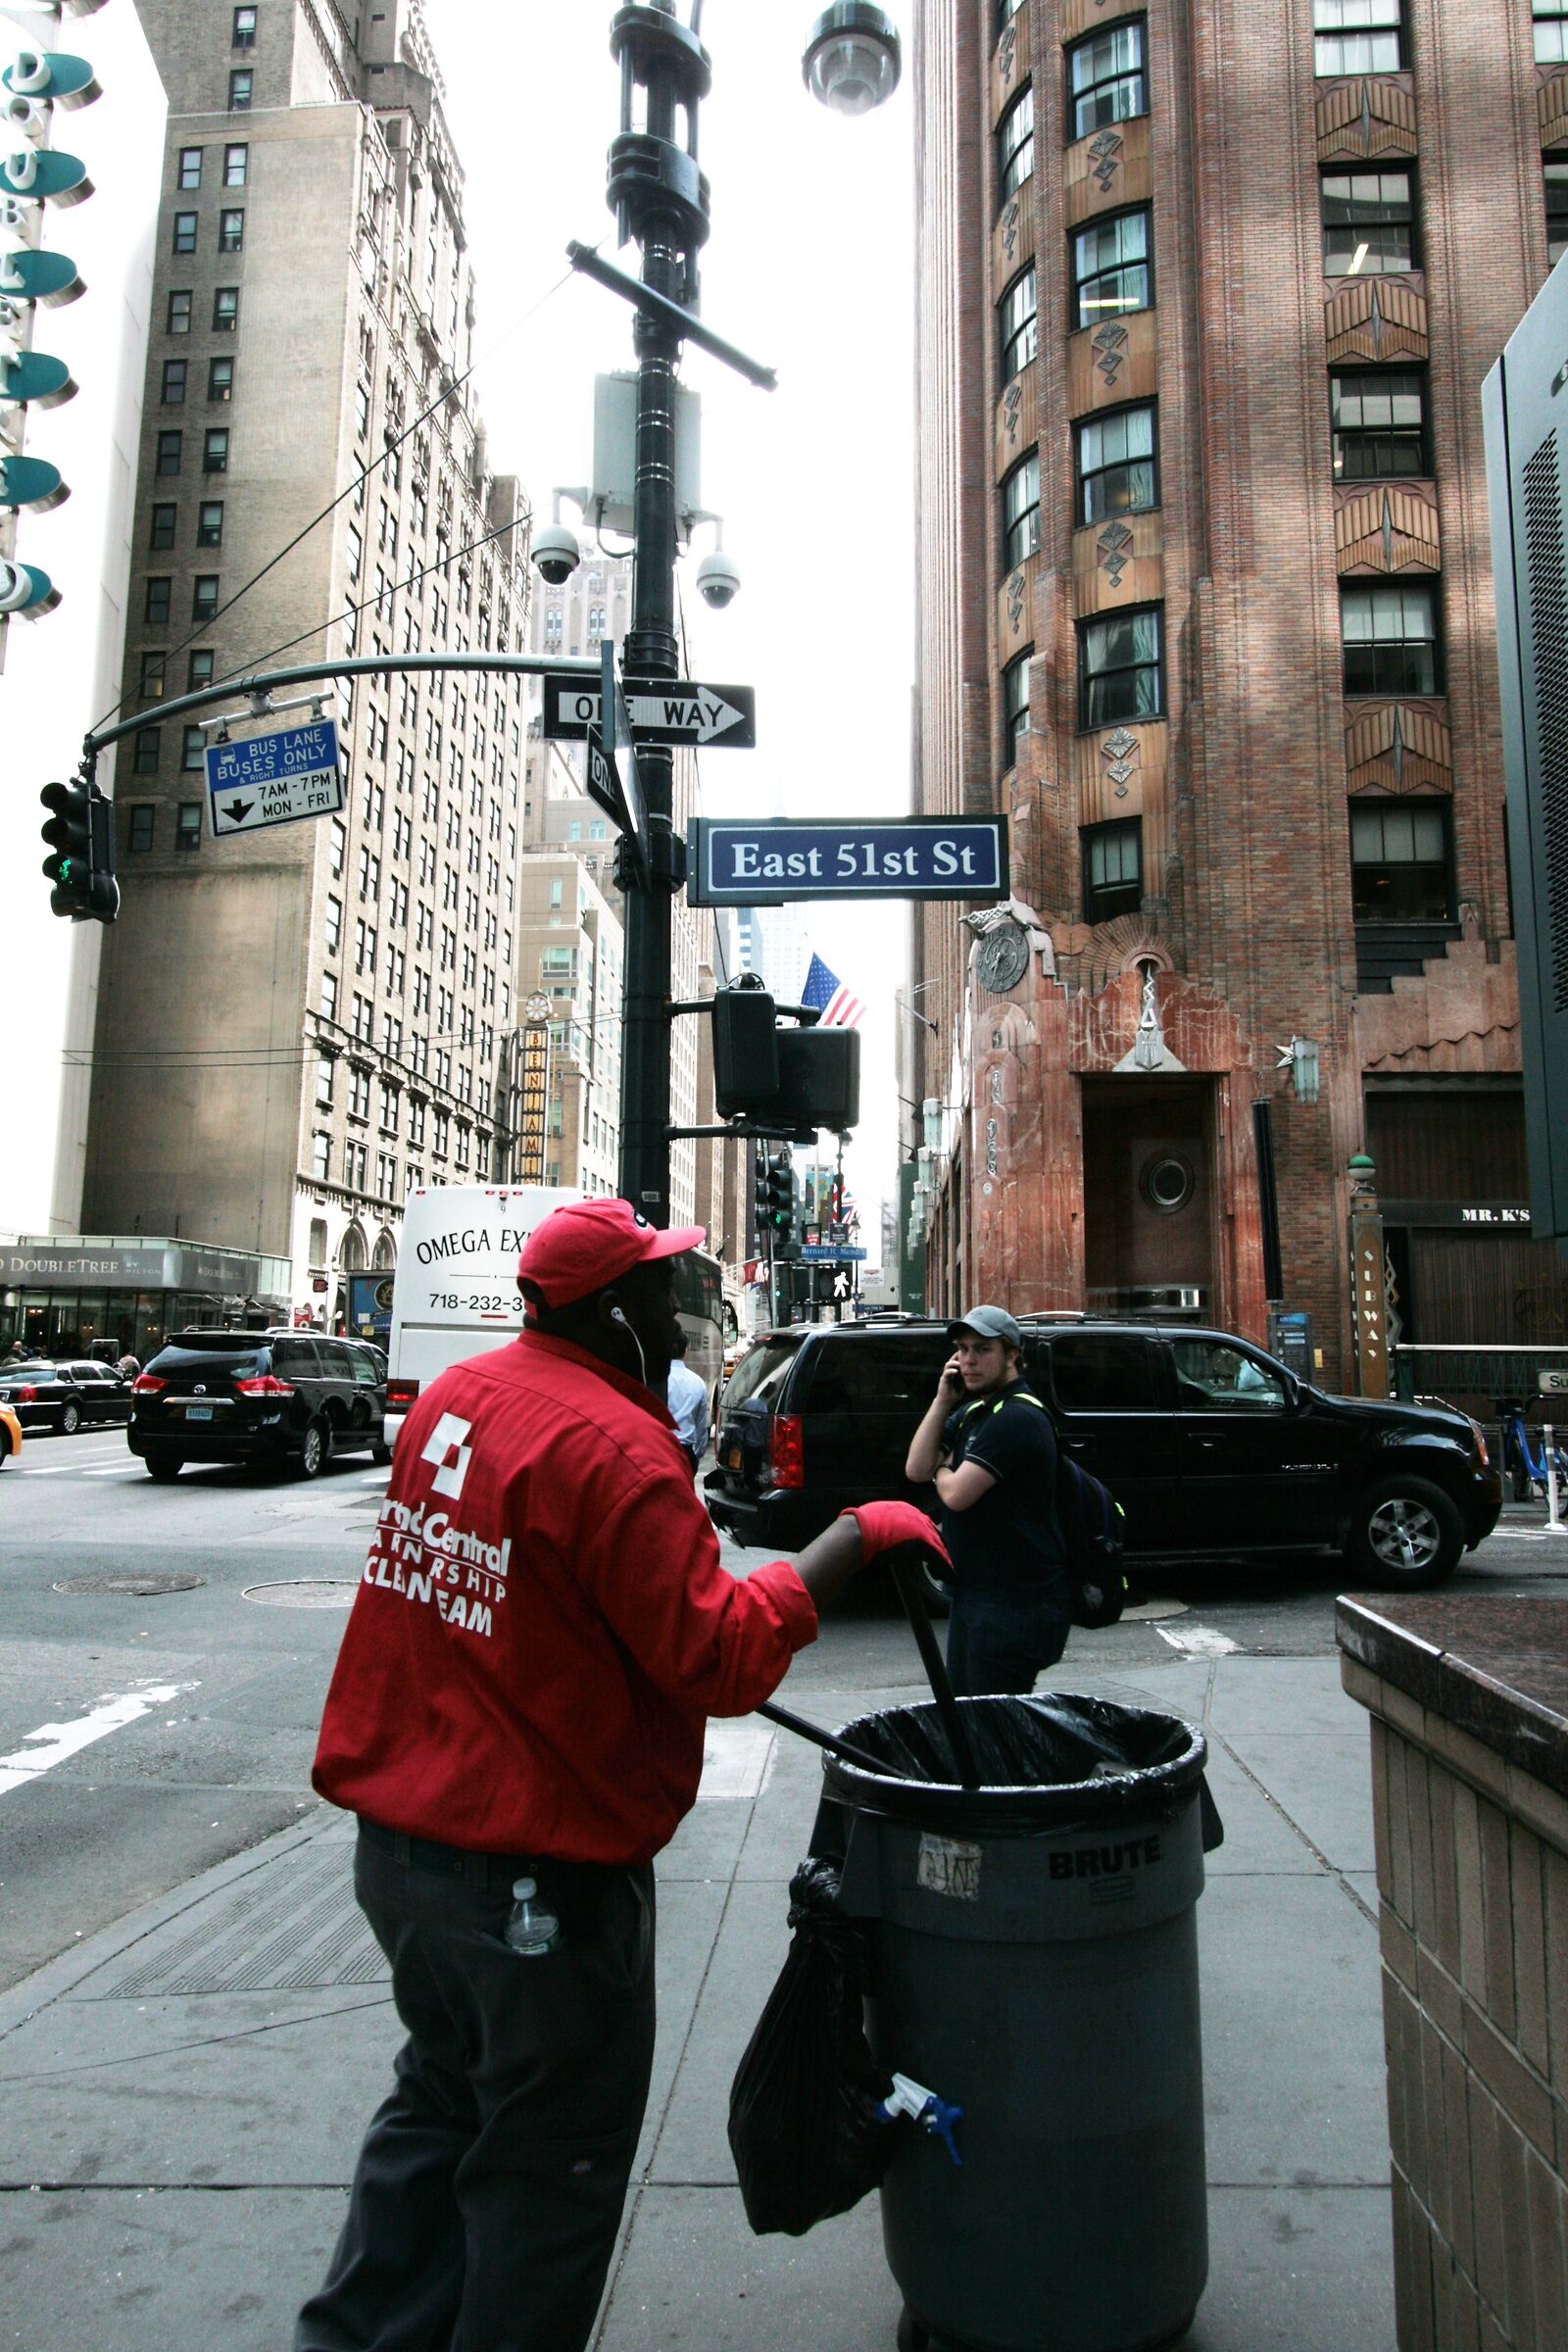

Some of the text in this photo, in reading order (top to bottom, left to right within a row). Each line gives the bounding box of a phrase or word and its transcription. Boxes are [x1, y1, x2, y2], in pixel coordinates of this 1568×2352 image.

[663, 701, 724, 727] WAY
[249, 729, 322, 758] BUS LANE
[218, 744, 327, 780] BUSES ONLY
[250, 770, 274, 782] RIGHT
[279, 762, 309, 775] TURNS
[594, 755, 615, 795] ON
[263, 800, 292, 817] MON
[308, 791, 330, 808] FRI
[731, 840, 976, 878] East 51st St
[526, 1031, 540, 1185] BENJAMI
[1461, 1208, 1531, 1222] MR. K'S
[416, 1229, 532, 1265] OMEGA EX
[429, 1293, 523, 1312] 718-232-3
[364, 1555, 433, 1604] CLEN
[435, 1589, 492, 1638] EAM
[1049, 1834, 1161, 1880] BRUTE
